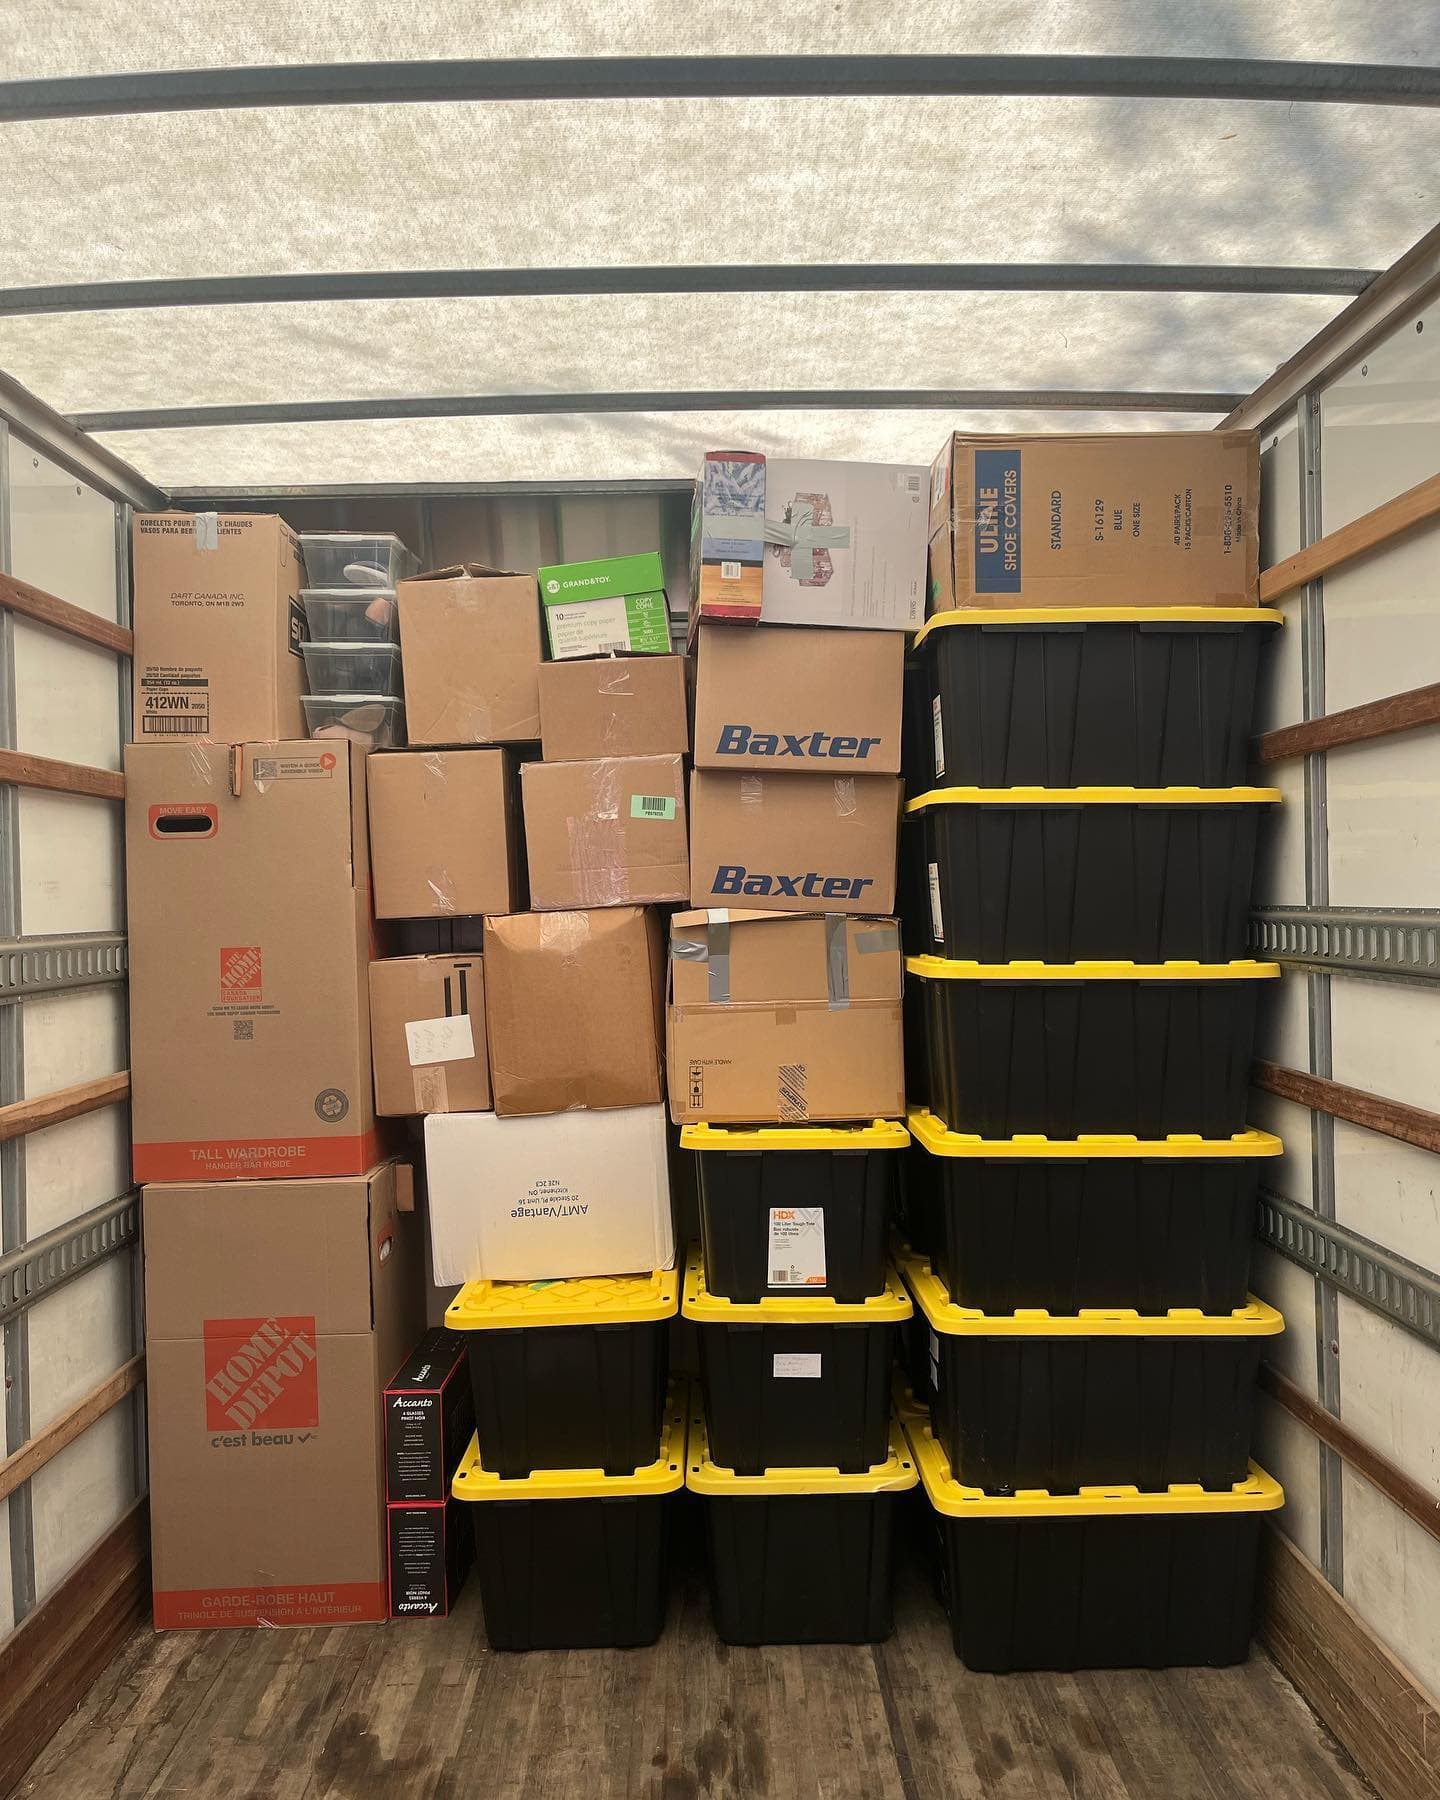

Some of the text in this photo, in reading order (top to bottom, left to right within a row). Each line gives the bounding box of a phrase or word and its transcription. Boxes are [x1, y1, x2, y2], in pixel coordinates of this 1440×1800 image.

[140, 519, 172, 527] GOBELETS
[979, 487, 999, 553] ULINE
[1004, 470, 1017, 571] SHOE COVERS
[1051, 490, 1062, 550] STANDARD
[1094, 499, 1104, 541] S-16129
[1114, 509, 1122, 531] BLUE
[1132, 502, 1140, 538] ONE SIZE
[1173, 536, 1181, 545] 40
[1185, 542, 1192, 550] 15
[170, 592, 193, 600] DART
[194, 592, 228, 600] CANADA
[555, 613, 564, 621] 10
[146, 696, 189, 709] 412WN
[715, 724, 881, 759] Baxter
[160, 806, 208, 815] MOVE EASY
[710, 864, 874, 899] Baxter
[221, 947, 264, 988] HOME
[237, 963, 262, 987] DEPOT
[189, 1145, 306, 1161] TALL WARDROBE
[205, 1160, 292, 1170] HANGER BAR INSIDE
[571, 1194, 579, 1202] 20
[510, 1204, 589, 1218] AMT/Vantage
[773, 1210, 796, 1220] HDX
[206, 1318, 290, 1406] HOME
[224, 1331, 317, 1430] DEPOT
[392, 1396, 433, 1408] Accanto
[211, 1431, 294, 1448] c'est beau
[202, 1591, 335, 1608] GARDE-ROBE HAUT
[178, 1611, 218, 1620] TRINGLE
[220, 1610, 233, 1618] DE
[235, 1607, 294, 1617] SUSPENSION
[398, 1602, 438, 1614] Accanto
